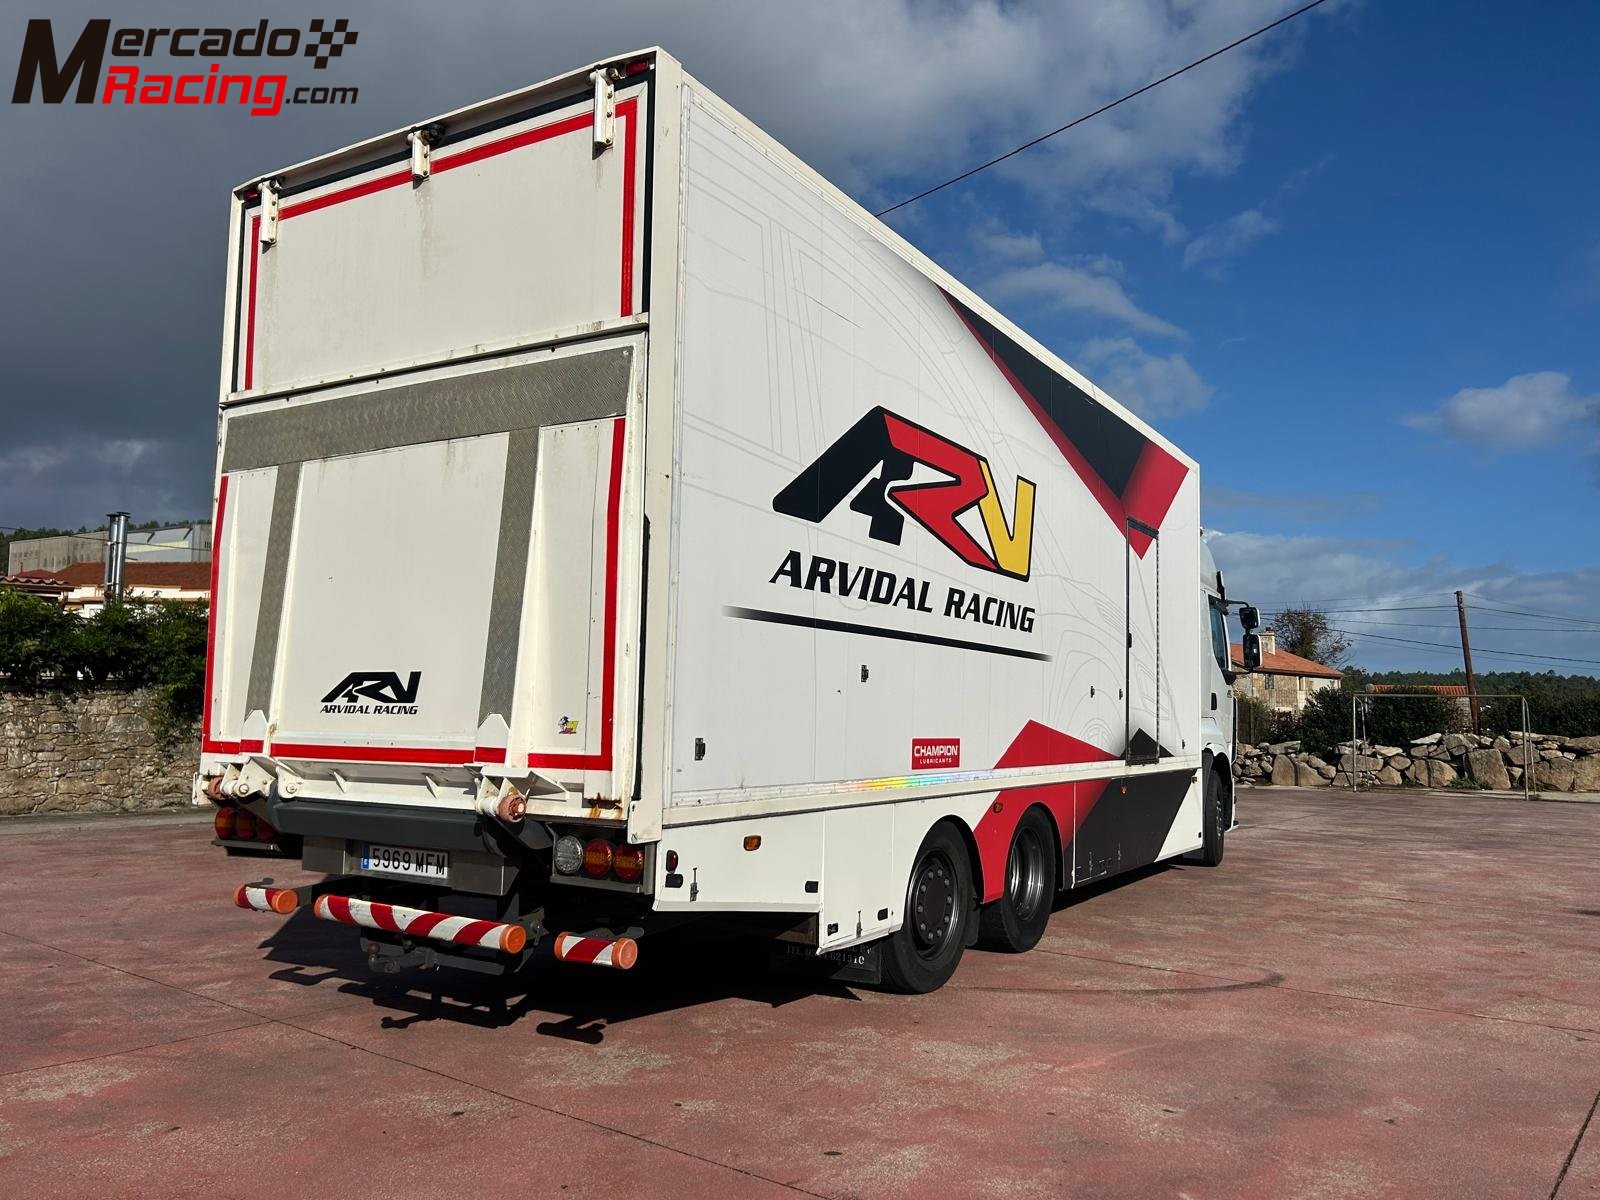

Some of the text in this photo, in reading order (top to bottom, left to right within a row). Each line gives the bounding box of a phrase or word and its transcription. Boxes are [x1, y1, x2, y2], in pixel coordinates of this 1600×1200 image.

[769, 550, 1036, 633] ARVIDAL RACING
[320, 705, 419, 715] ARVIDAL RACING
[914, 745, 958, 757] CHAMPION
[919, 757, 952, 765] LUBRICANTS
[372, 847, 446, 875] 5969 MFM
